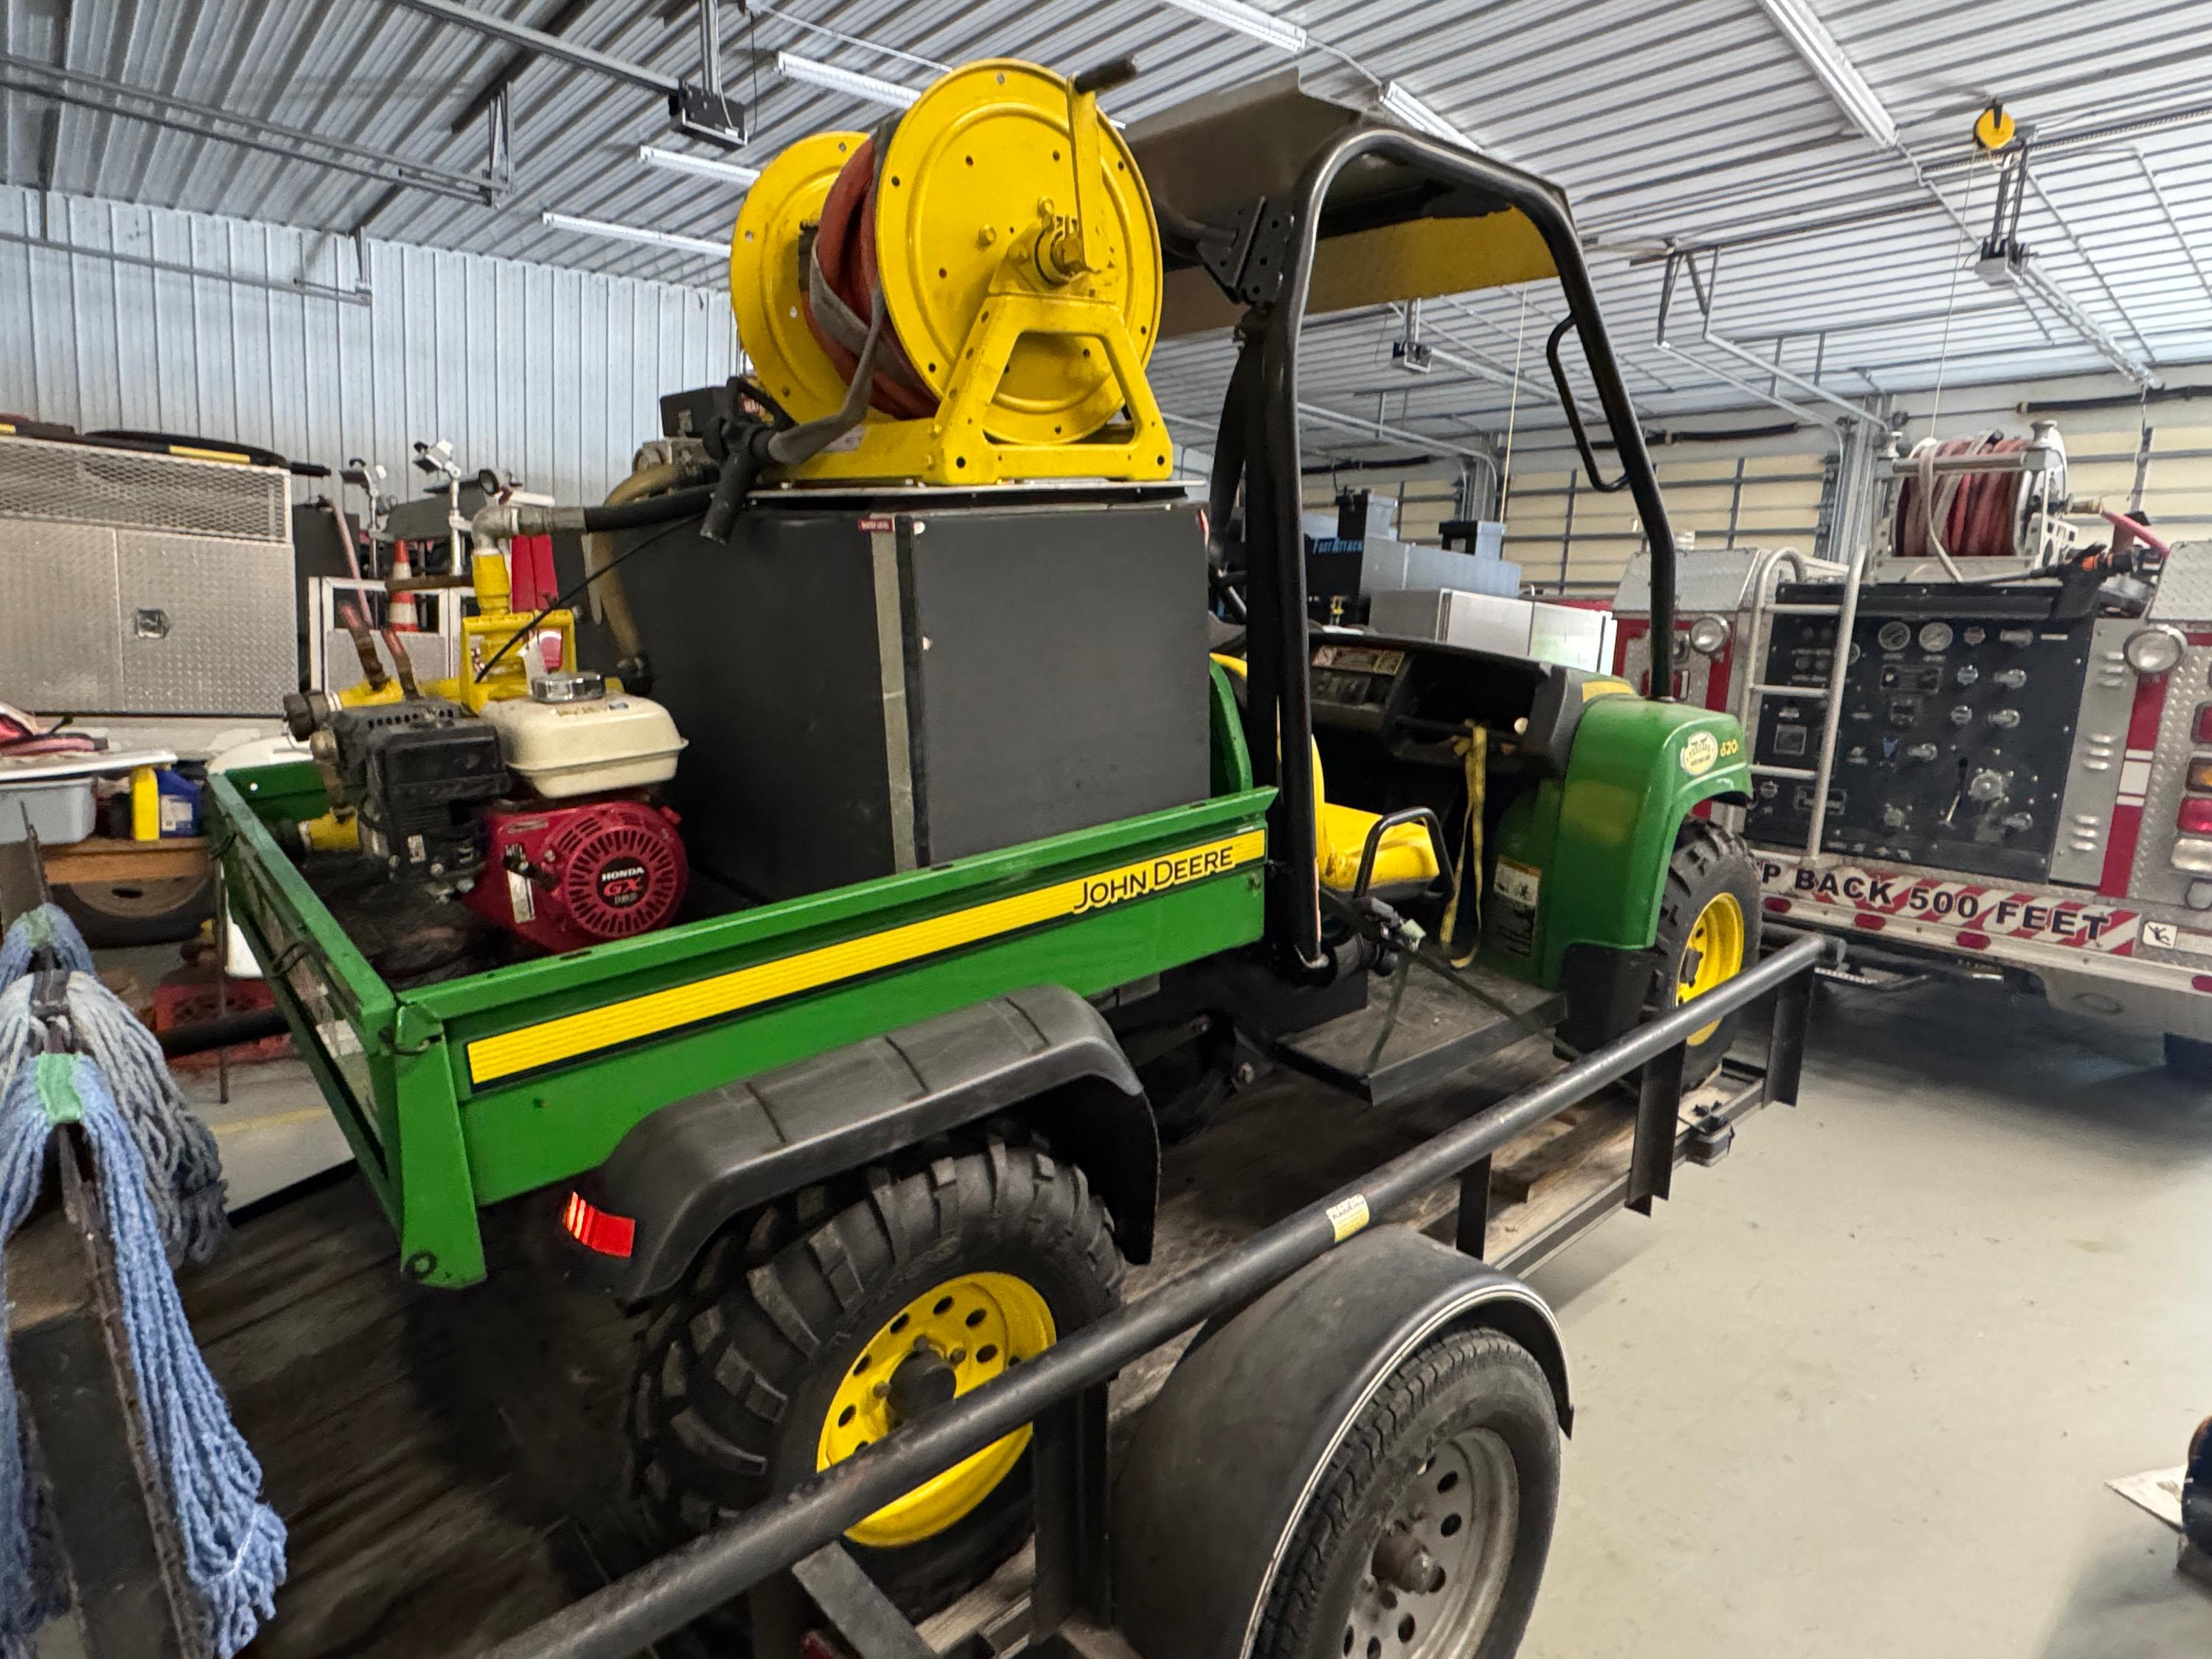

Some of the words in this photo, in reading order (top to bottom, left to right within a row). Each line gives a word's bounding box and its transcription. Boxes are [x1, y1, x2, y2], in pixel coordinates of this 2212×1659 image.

[601, 866, 646, 882] HONDA
[603, 876, 644, 897] GX
[1073, 869, 1147, 911] JOHN
[1153, 845, 1234, 888] DEERE
[1795, 869, 1894, 905] BACK
[1908, 887, 1979, 919] 500
[1996, 900, 2110, 940] FEET
